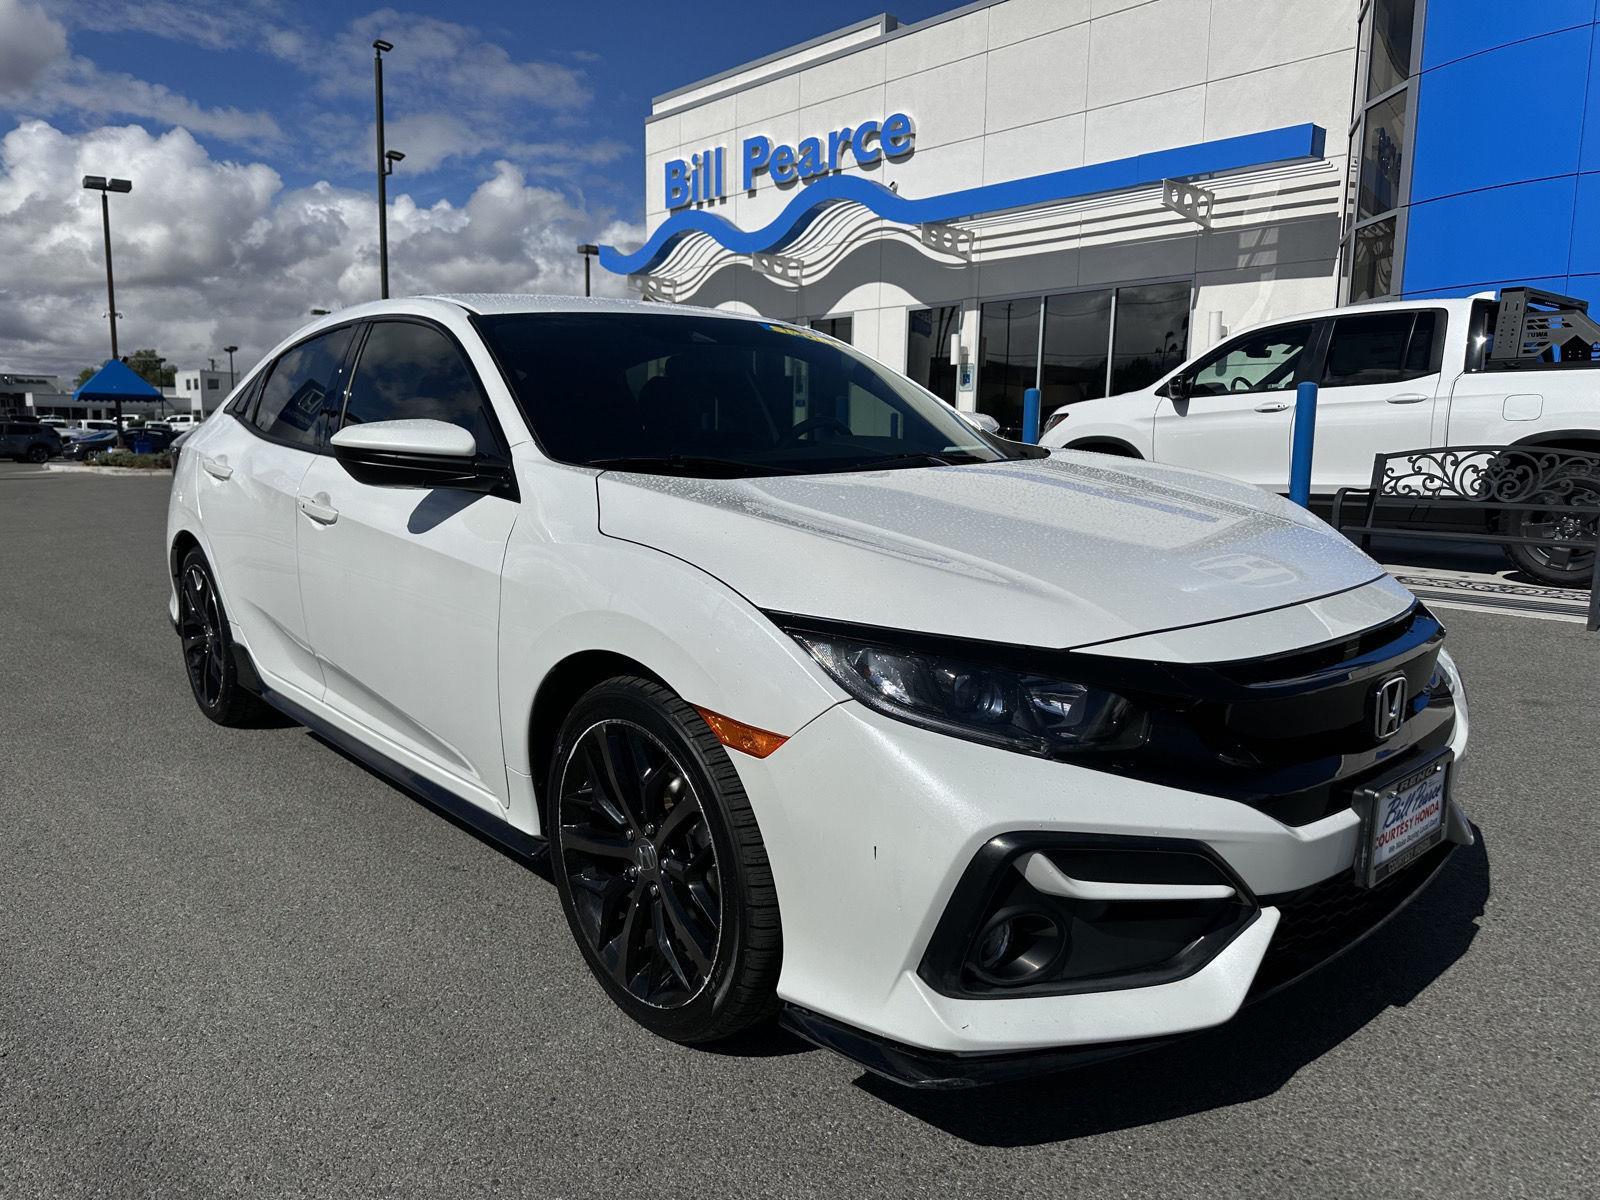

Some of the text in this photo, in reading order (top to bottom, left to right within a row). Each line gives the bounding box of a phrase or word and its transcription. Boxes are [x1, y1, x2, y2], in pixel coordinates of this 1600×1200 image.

[665, 113, 914, 209] Bill Pearce
[1383, 792, 1415, 830] Bill
[1415, 800, 1440, 826] HONDA
